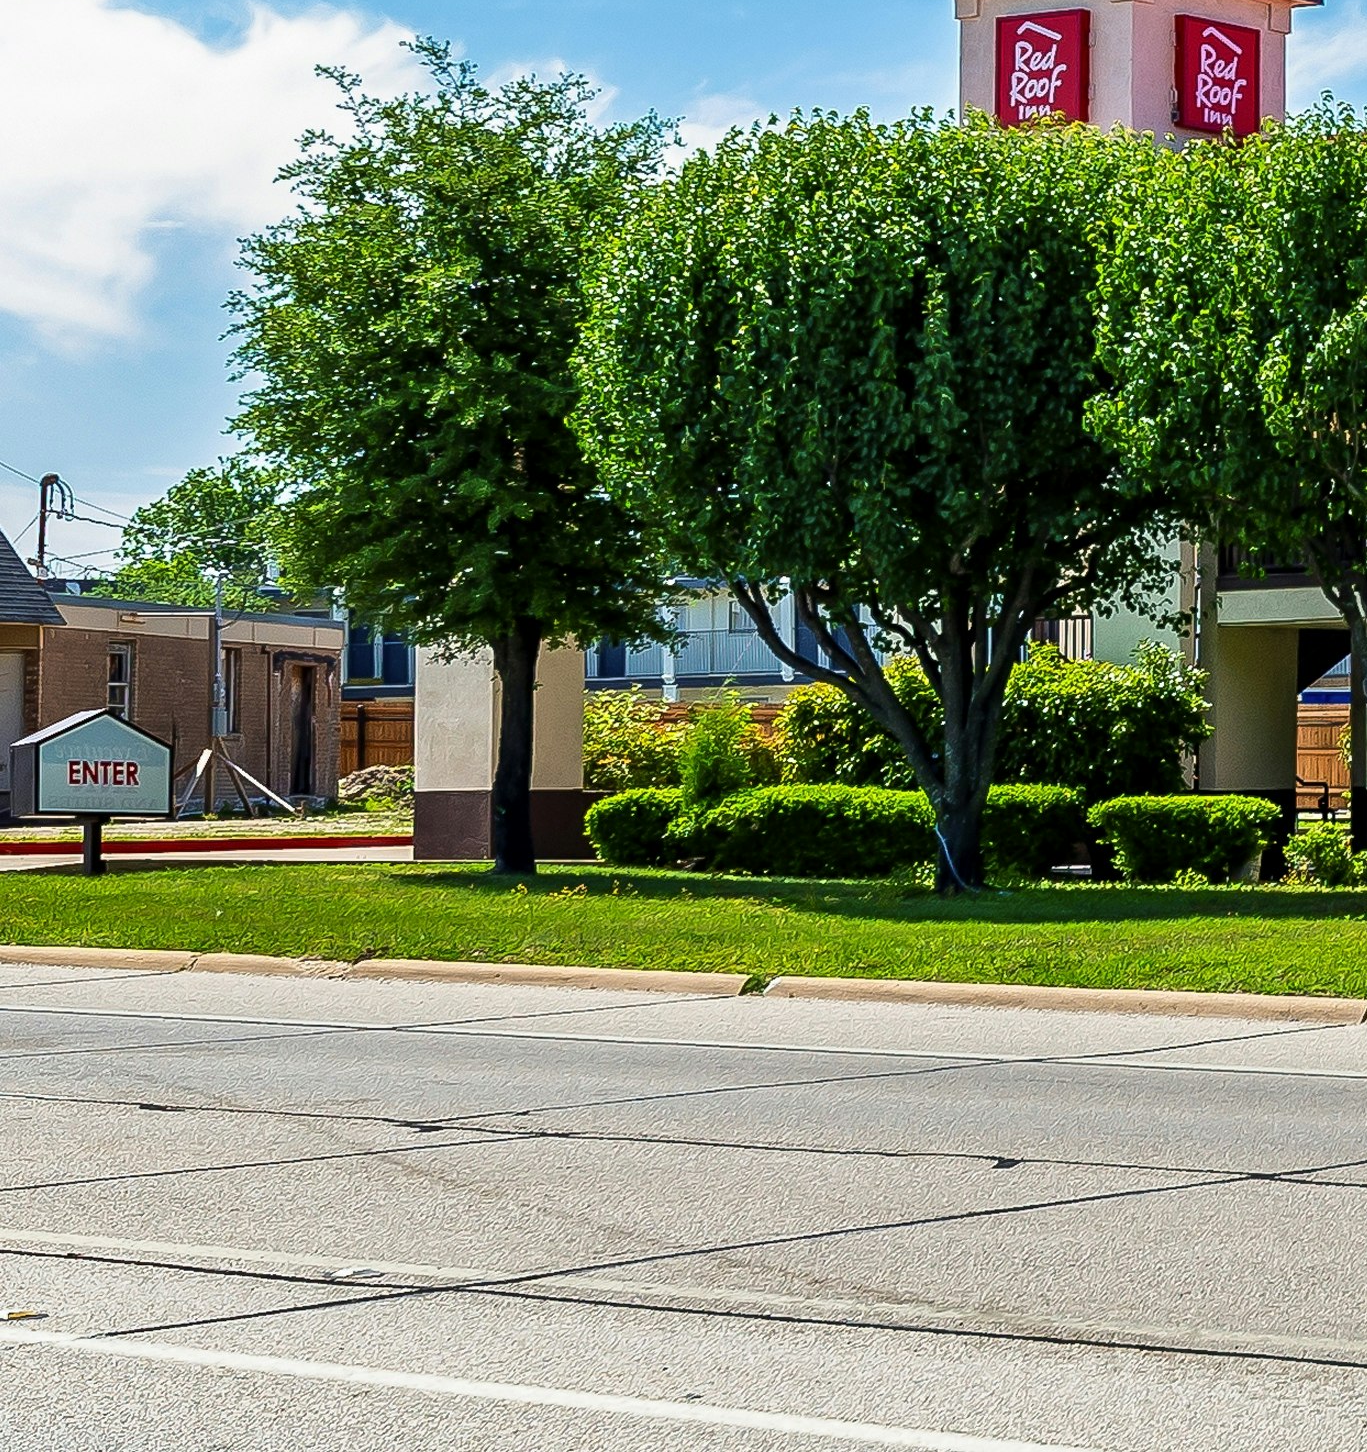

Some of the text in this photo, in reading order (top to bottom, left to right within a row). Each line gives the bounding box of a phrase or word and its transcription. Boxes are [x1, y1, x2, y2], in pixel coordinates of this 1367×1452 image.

[1014, 40, 1057, 72] Red
[1200, 44, 1238, 81] Red
[1009, 71, 1067, 107] Roof
[1196, 73, 1247, 115] Roof
[67, 760, 140, 786] ENTER
